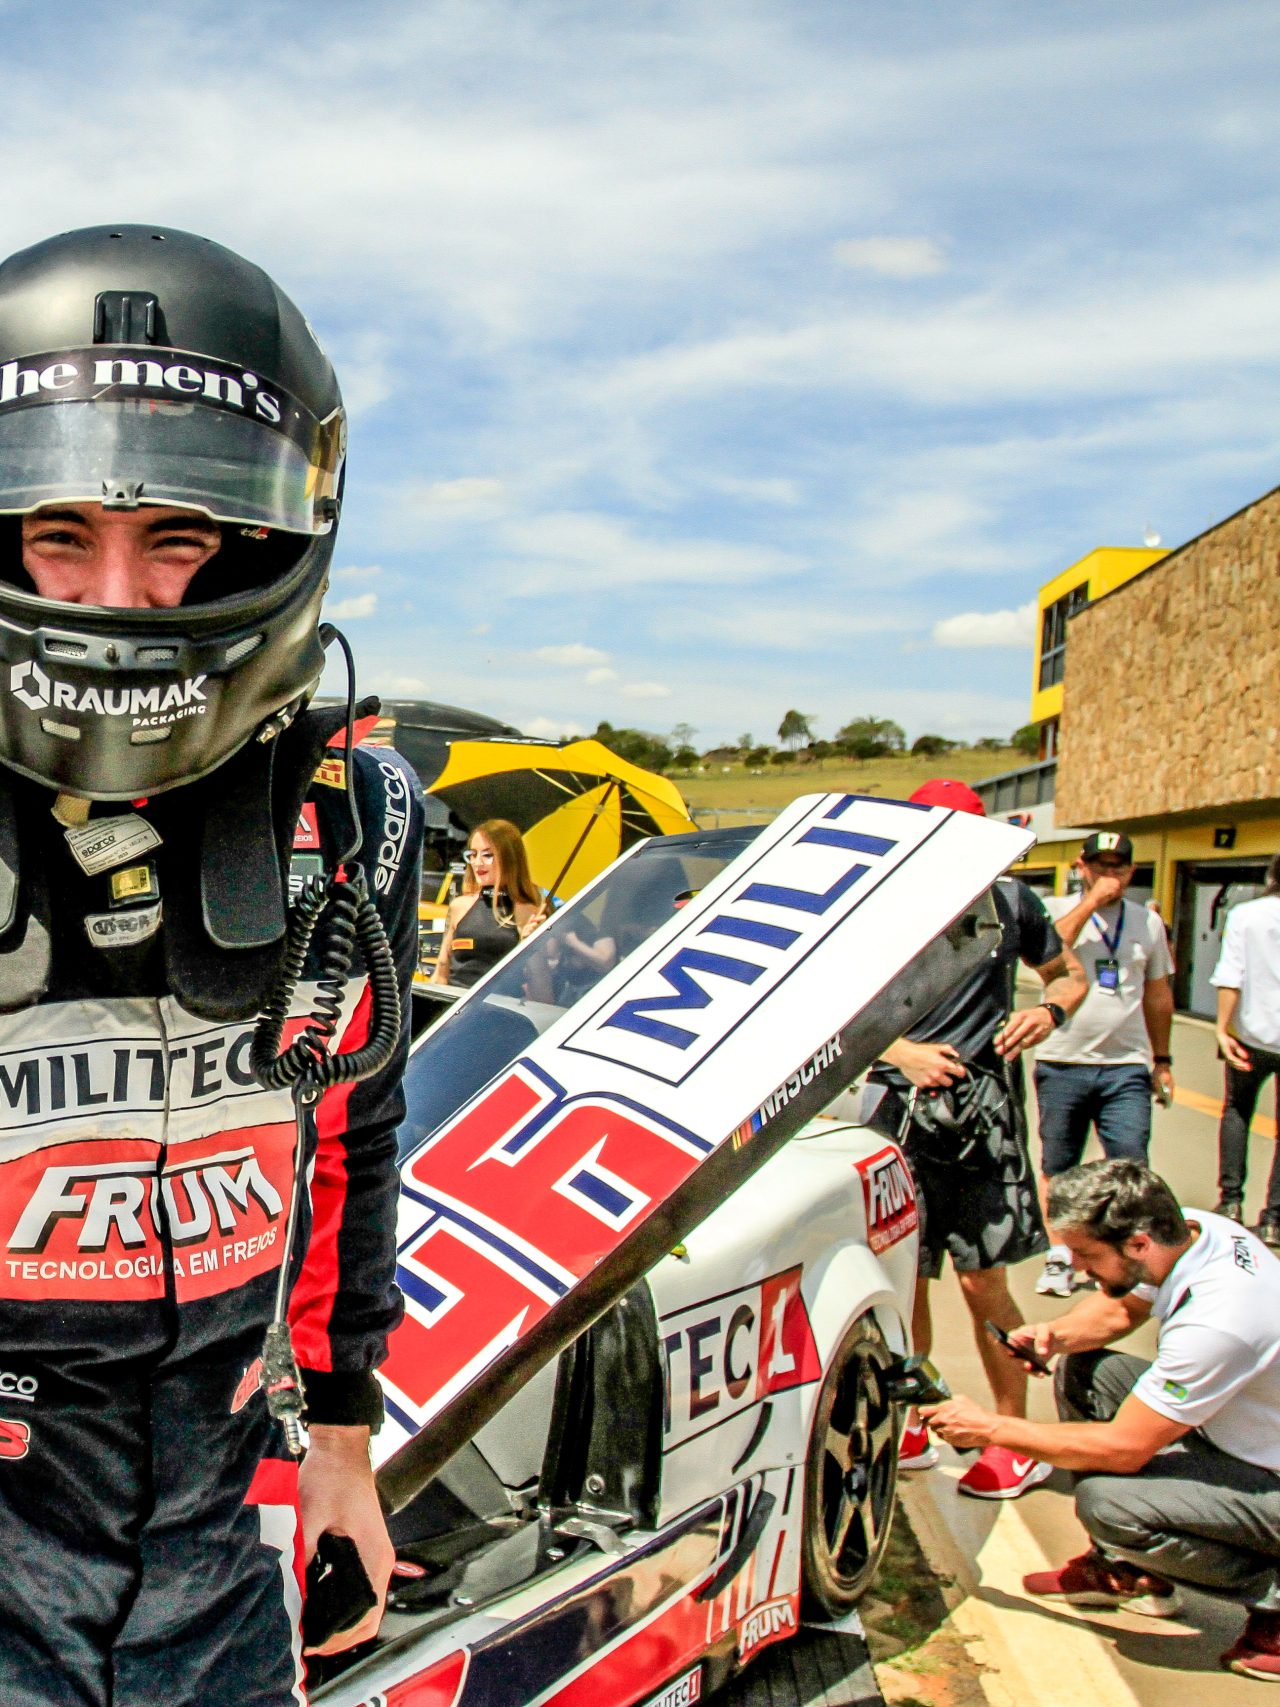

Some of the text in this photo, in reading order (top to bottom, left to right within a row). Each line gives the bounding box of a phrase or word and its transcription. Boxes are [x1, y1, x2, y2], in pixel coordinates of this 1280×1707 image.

[94, 358, 281, 424] men's
[53, 674, 207, 716] RAUMAK
[132, 705, 206, 727] PACKAGING
[374, 761, 411, 895] sparco
[759, 1033, 842, 1126] NASCAR
[6, 1146, 284, 1250] FRUM
[866, 1152, 914, 1226] FRUM
[5, 1226, 278, 1281] TECNOLOGIA EM FREIOS
[768, 1288, 795, 1379] 1
[739, 1600, 795, 1657] FRUM
